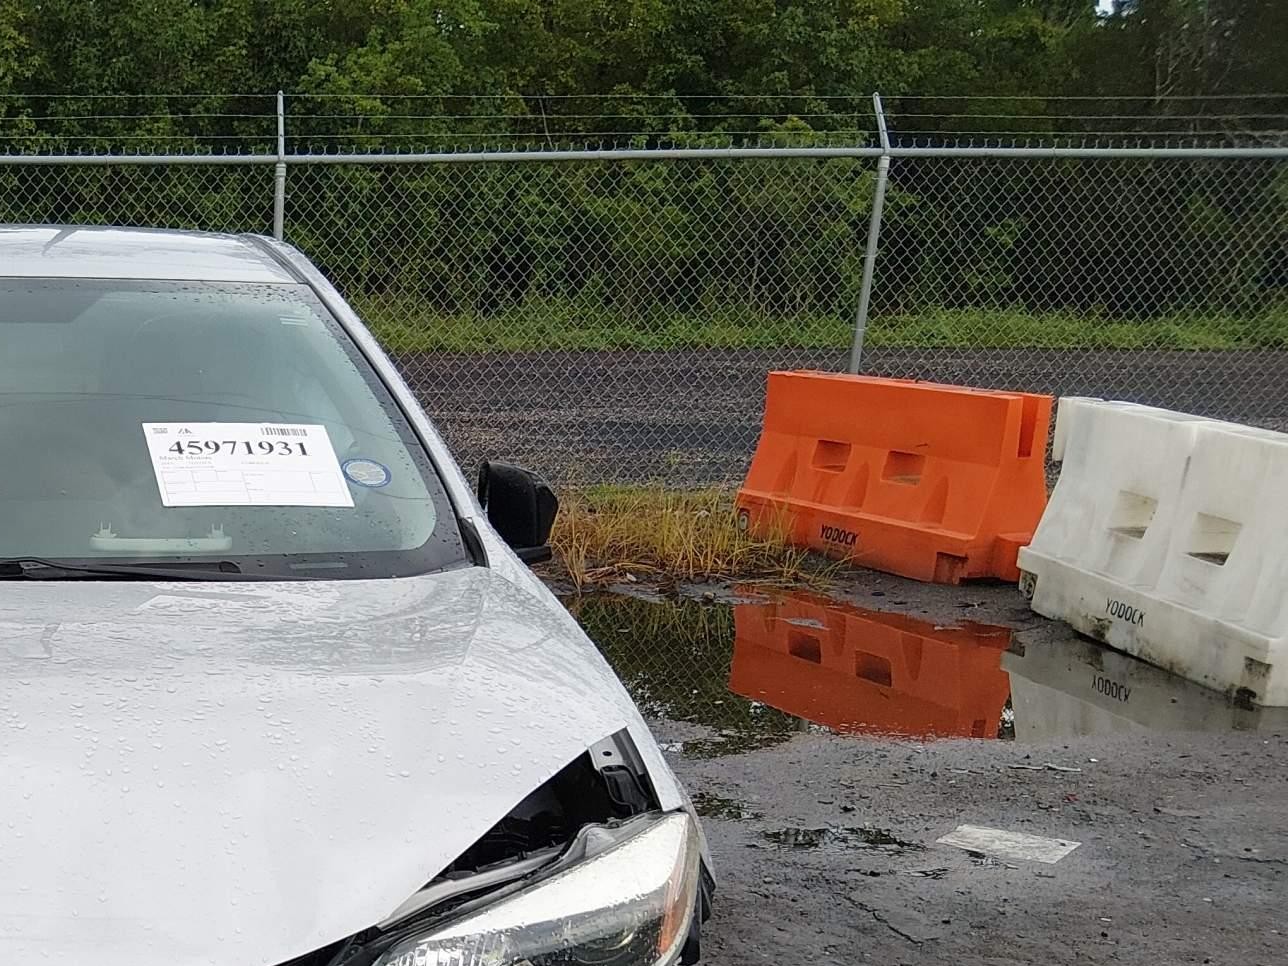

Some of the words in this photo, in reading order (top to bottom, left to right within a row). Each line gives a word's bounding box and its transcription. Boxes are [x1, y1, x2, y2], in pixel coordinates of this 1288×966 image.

[168, 440, 311, 456] 45971931
[820, 524, 858, 545] YODOCK
[1105, 597, 1145, 627] YODOCK
